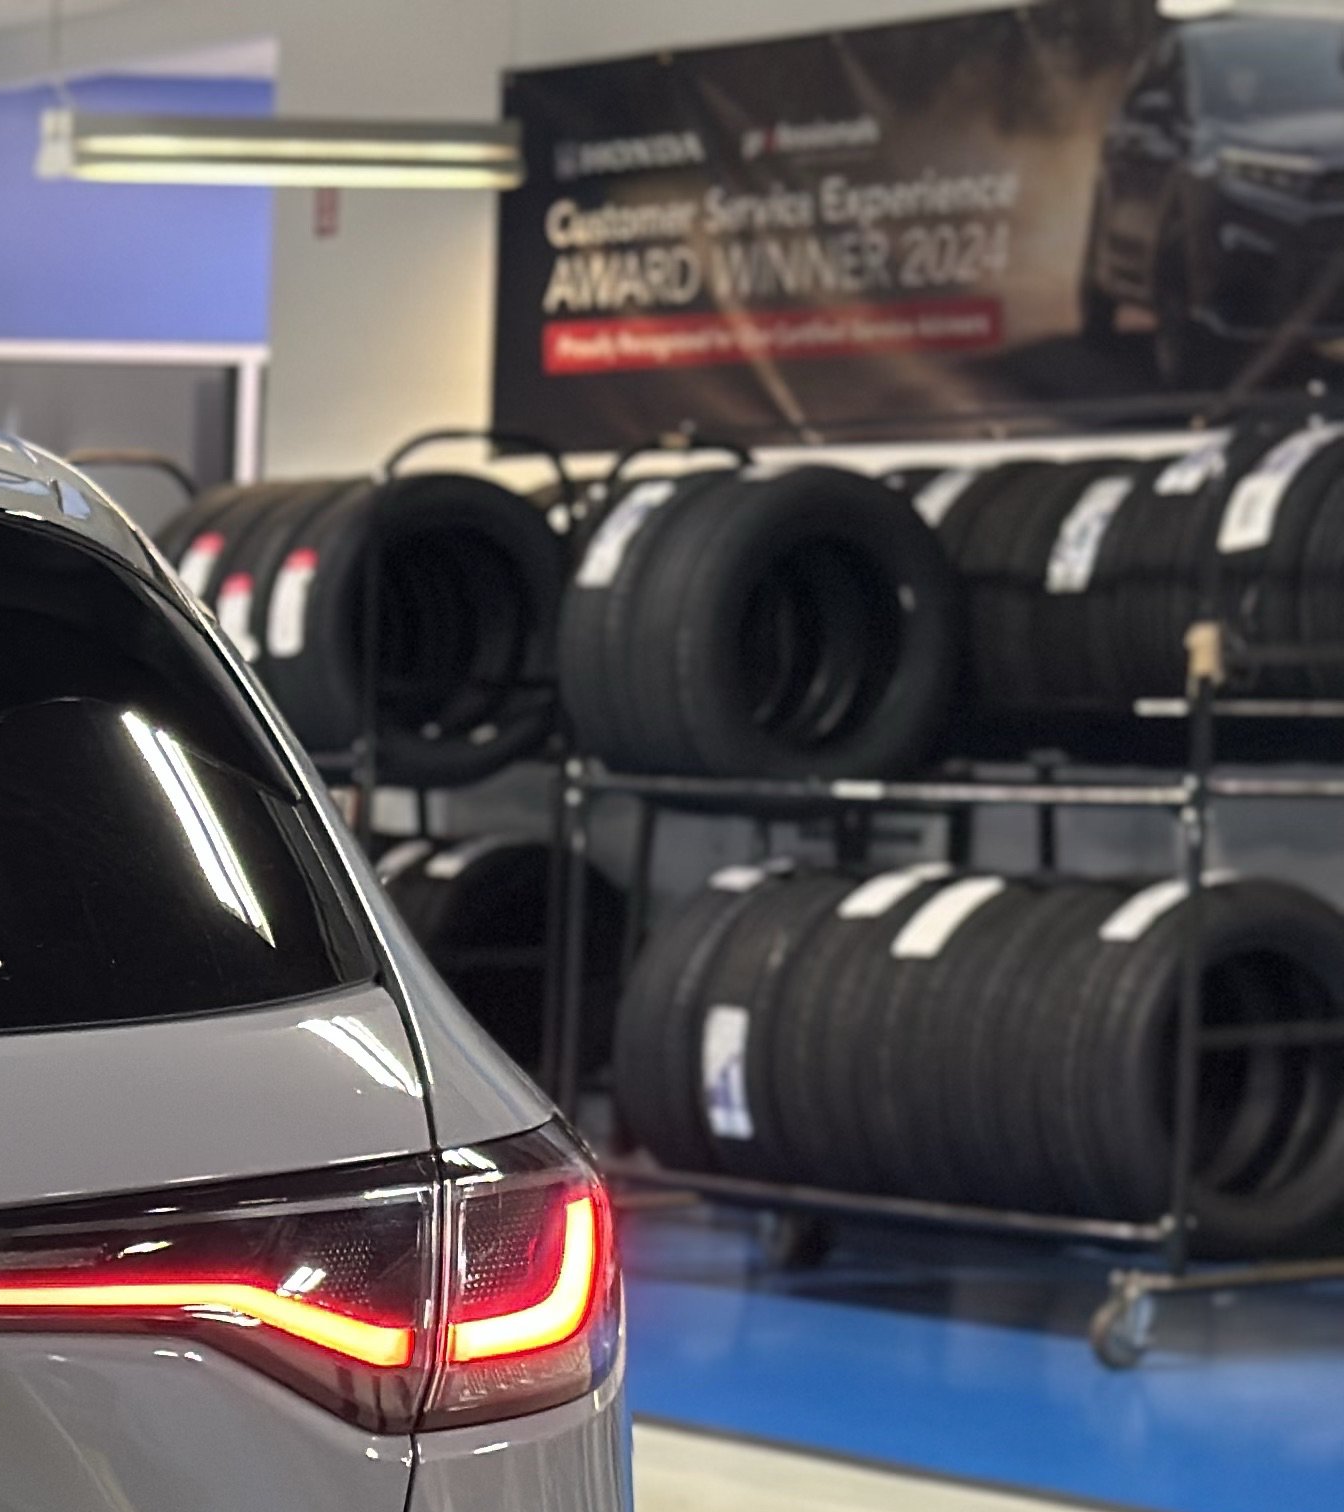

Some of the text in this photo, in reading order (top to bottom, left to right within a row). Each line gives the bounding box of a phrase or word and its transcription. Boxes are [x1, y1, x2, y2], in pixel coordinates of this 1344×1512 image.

[820, 165, 1019, 228] Experience
[542, 220, 1011, 313] AWARD WINNER 2024
